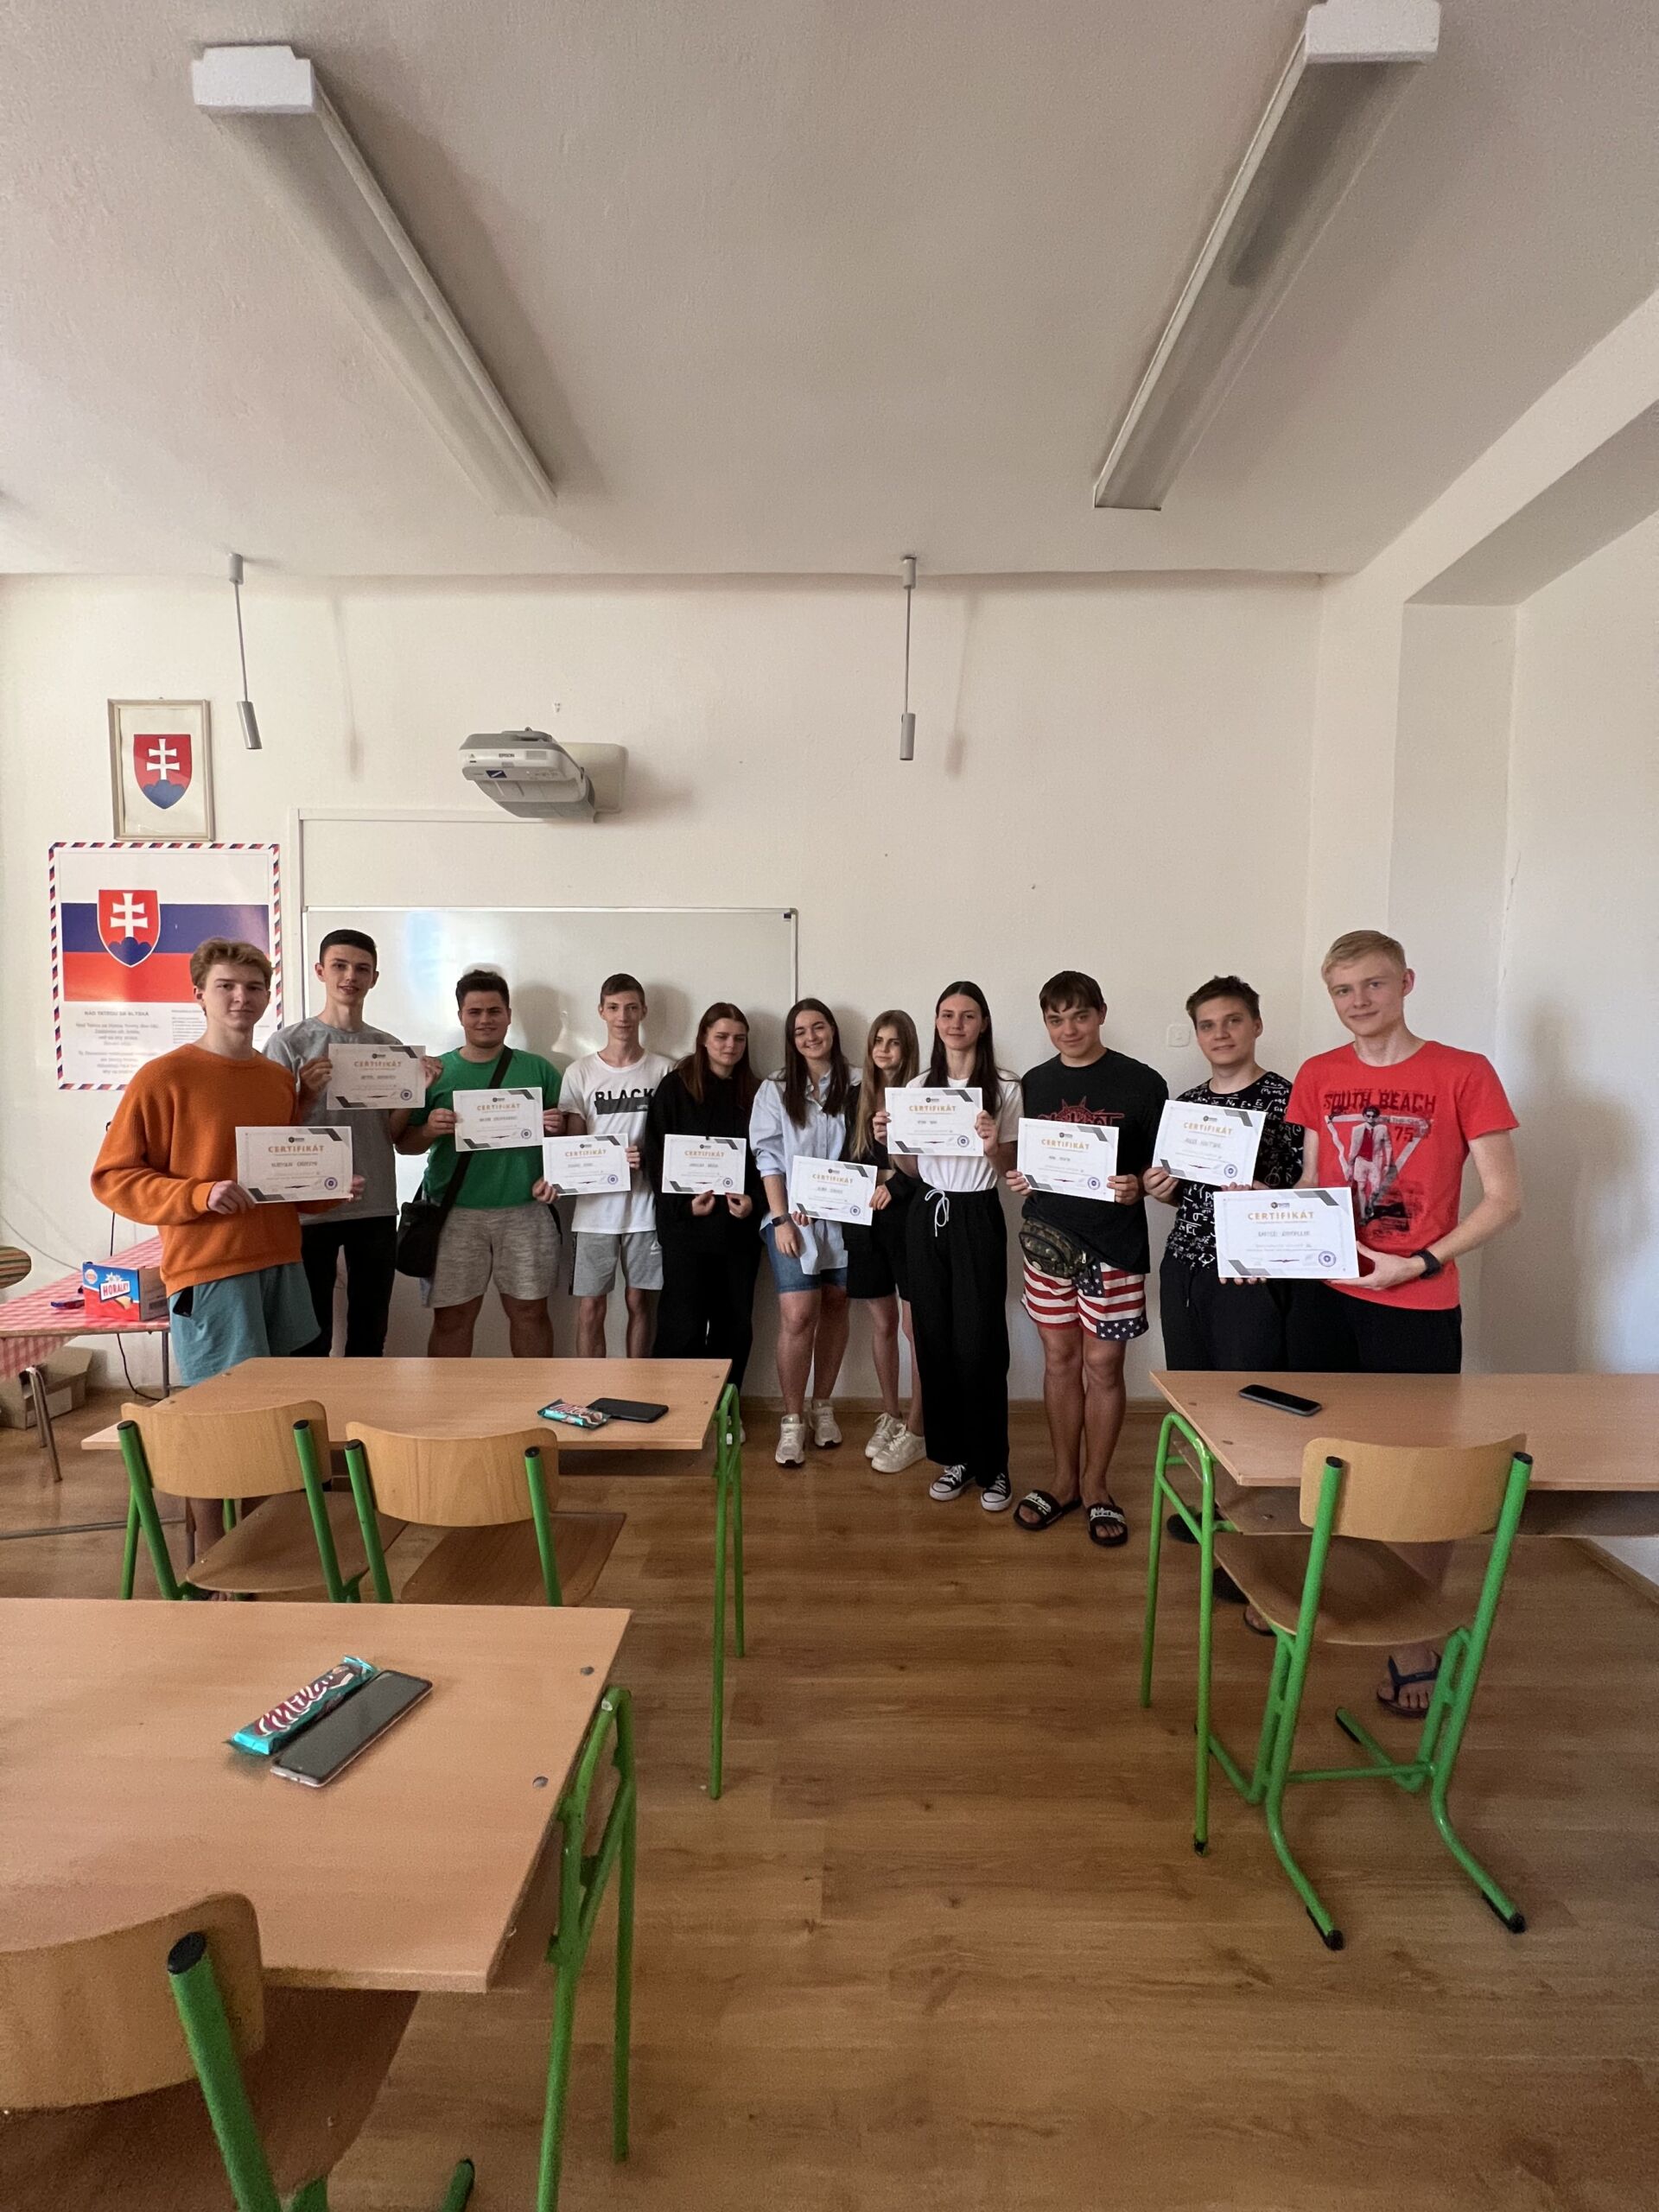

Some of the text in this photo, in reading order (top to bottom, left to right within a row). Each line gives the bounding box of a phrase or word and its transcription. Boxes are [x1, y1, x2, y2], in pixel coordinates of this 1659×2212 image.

[1324, 1090, 1437, 1116] SOUTH BEACH
[1395, 1126, 1414, 1142] 75
[268, 1144, 325, 1154] CERTIFIKÁT
[1247, 1209, 1314, 1221] CERTIFIKÁT
